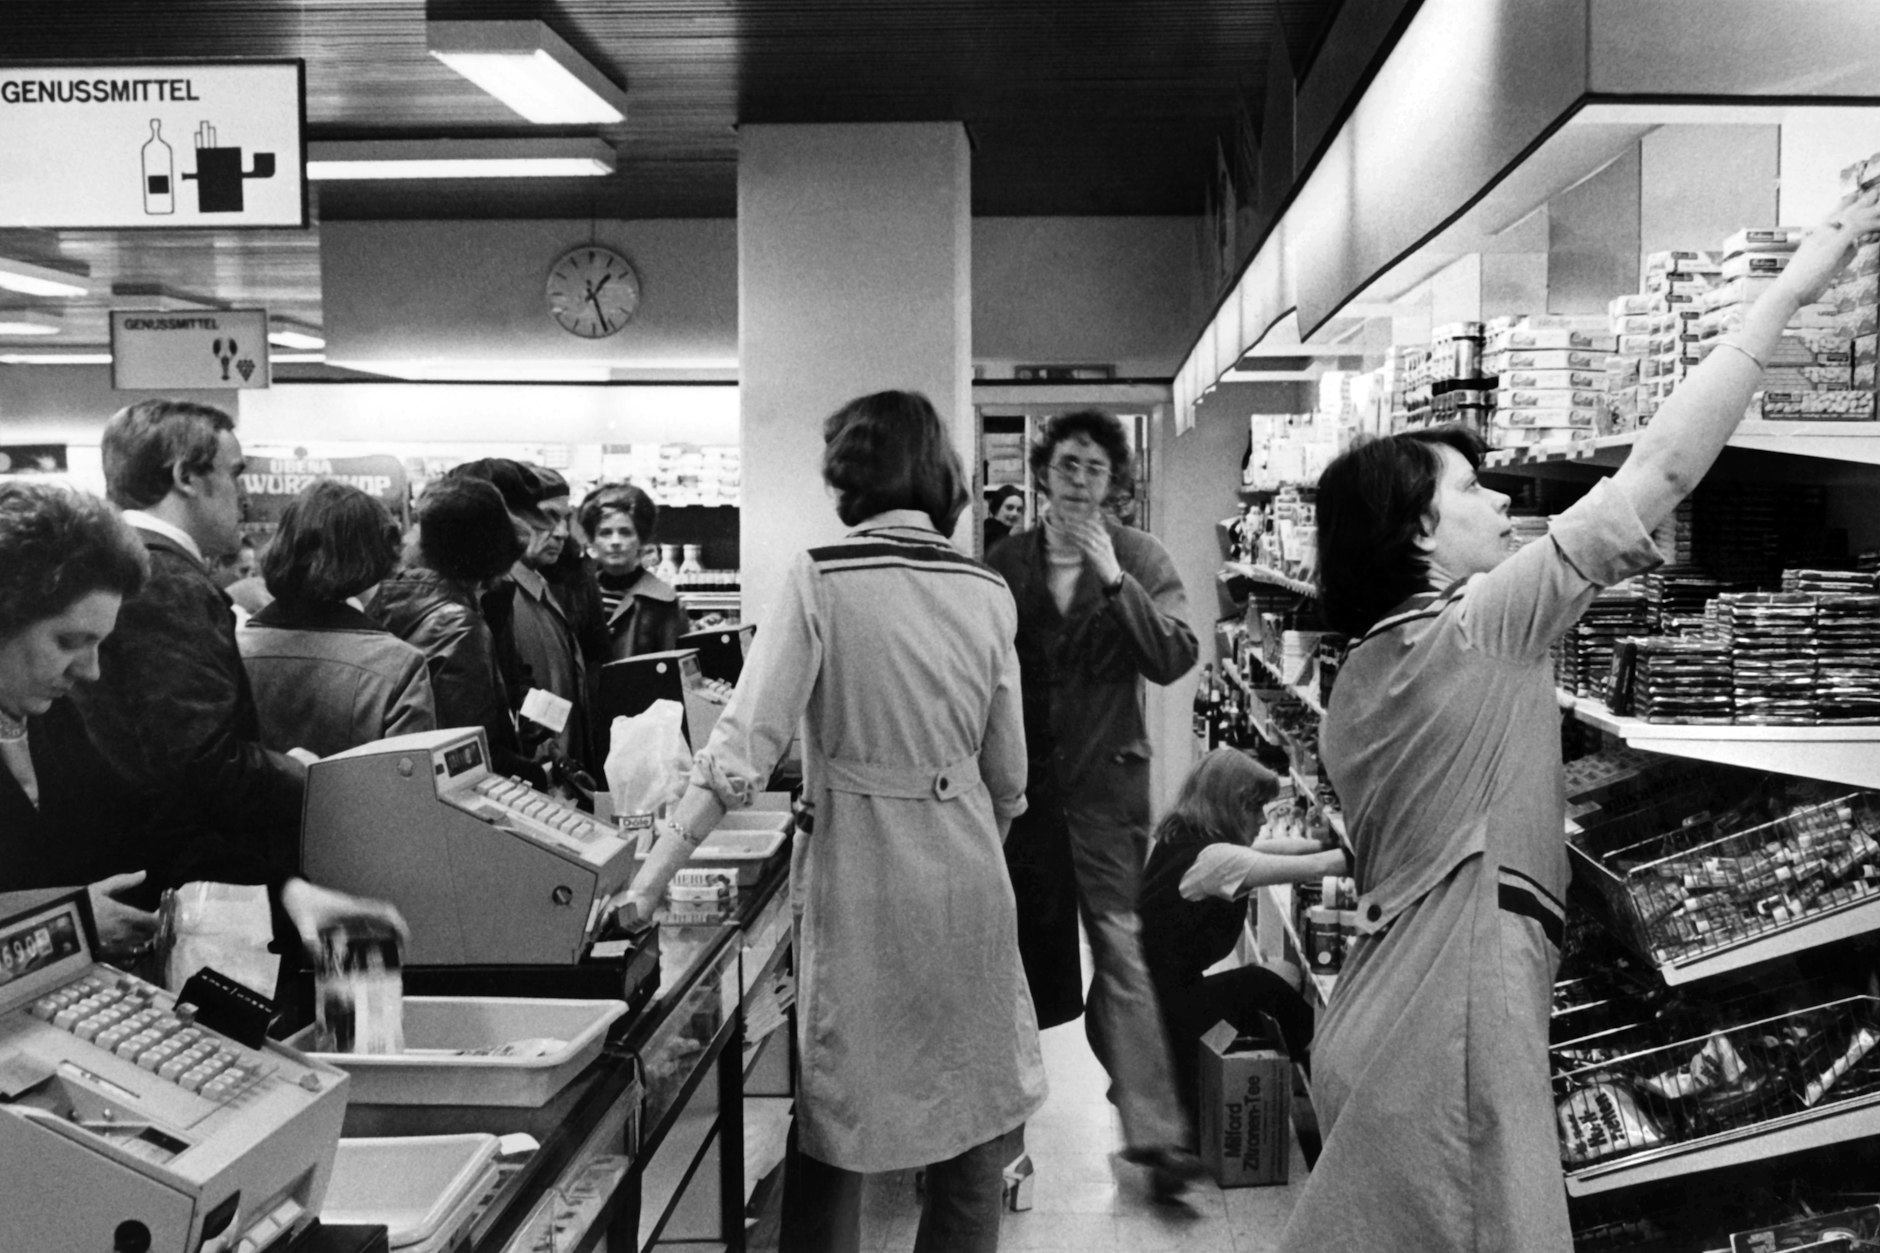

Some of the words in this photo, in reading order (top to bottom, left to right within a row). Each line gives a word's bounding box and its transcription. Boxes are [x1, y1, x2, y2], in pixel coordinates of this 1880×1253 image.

[1, 79, 200, 103] GENUSSMITTEL
[124, 318, 219, 330] GENUSSMITTEL
[269, 459, 332, 474] UBENA
[1224, 1103, 1242, 1158] Milford
[1243, 1075, 1261, 1171] Zitronen-Tee
